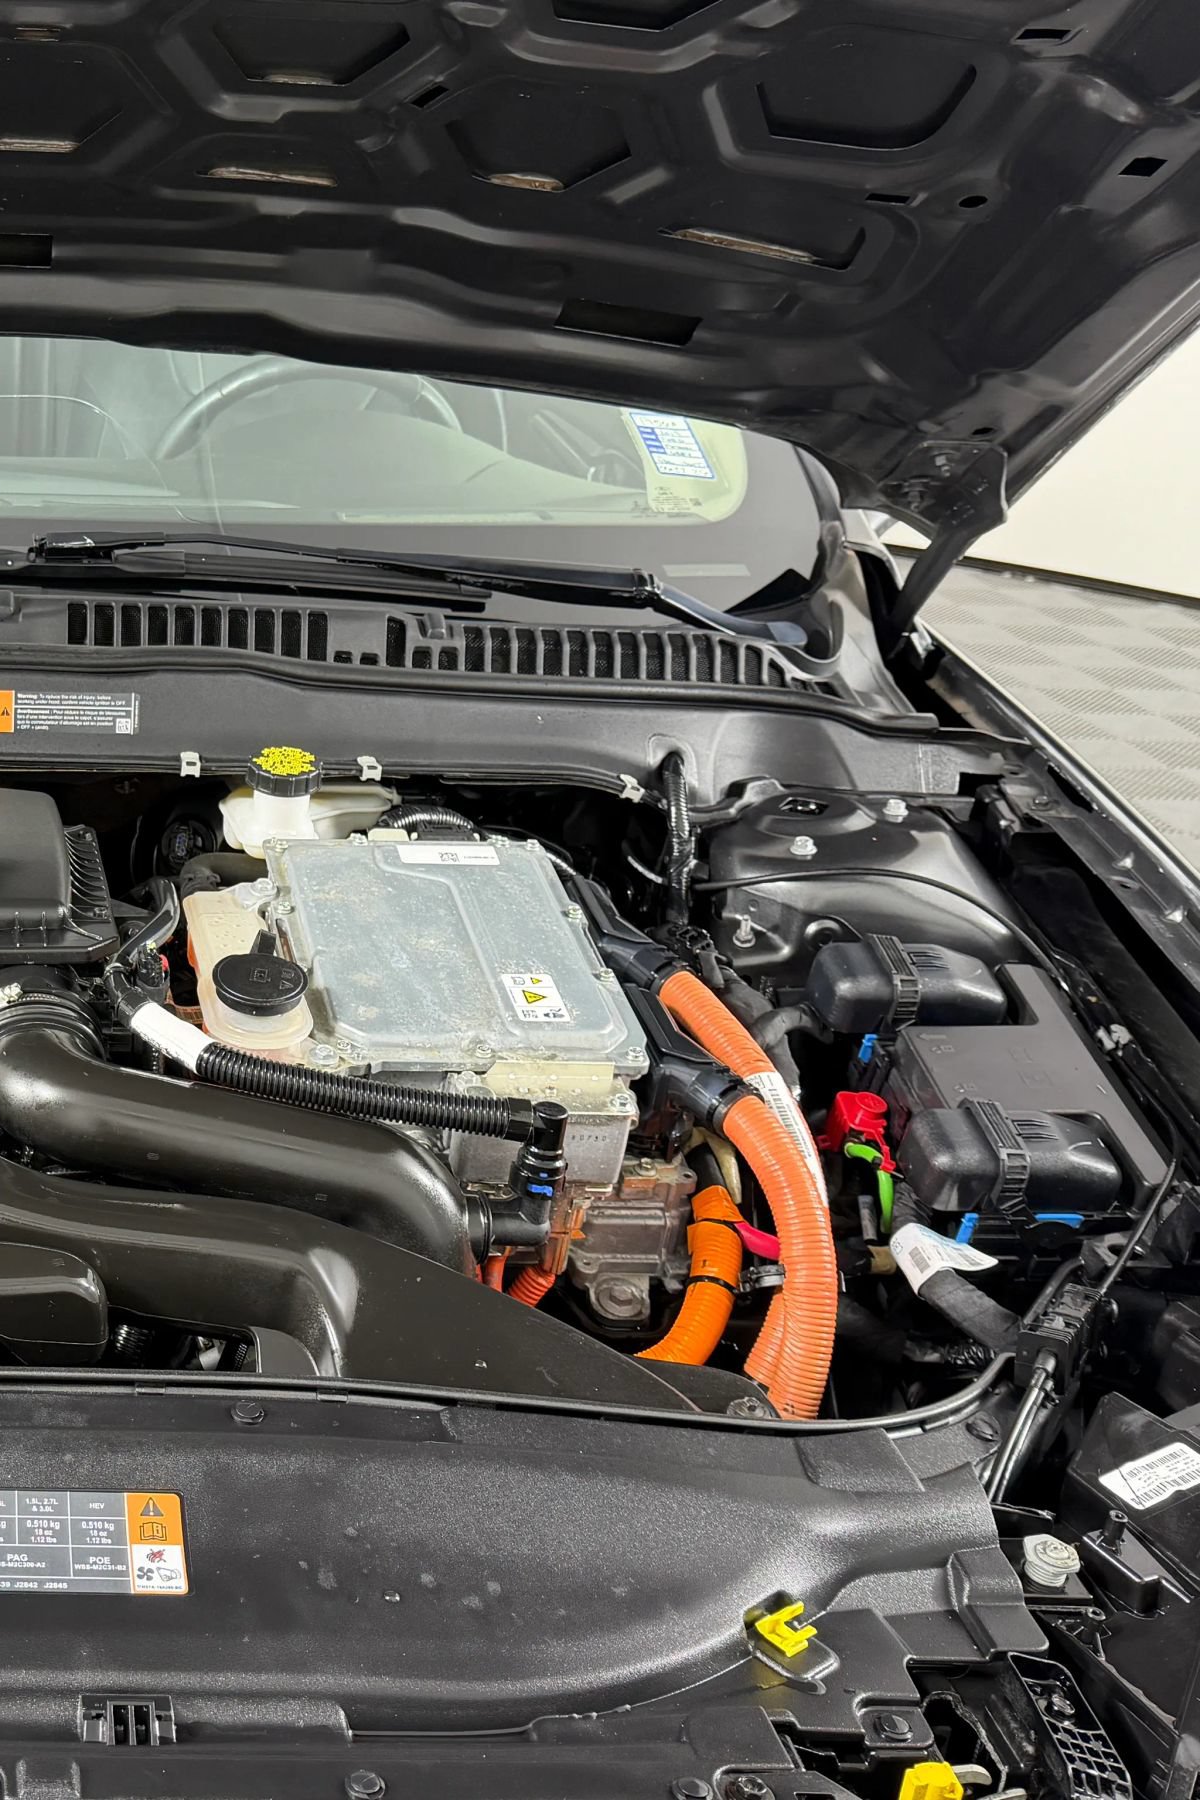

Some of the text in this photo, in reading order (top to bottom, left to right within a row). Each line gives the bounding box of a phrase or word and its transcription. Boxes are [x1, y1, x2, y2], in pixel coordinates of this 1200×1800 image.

[26, 1519, 60, 1530] 0.510 kg
[81, 1521, 115, 1531] 0.510 kg
[6, 1553, 28, 1562] PAG
[89, 1556, 111, 1565] POE
